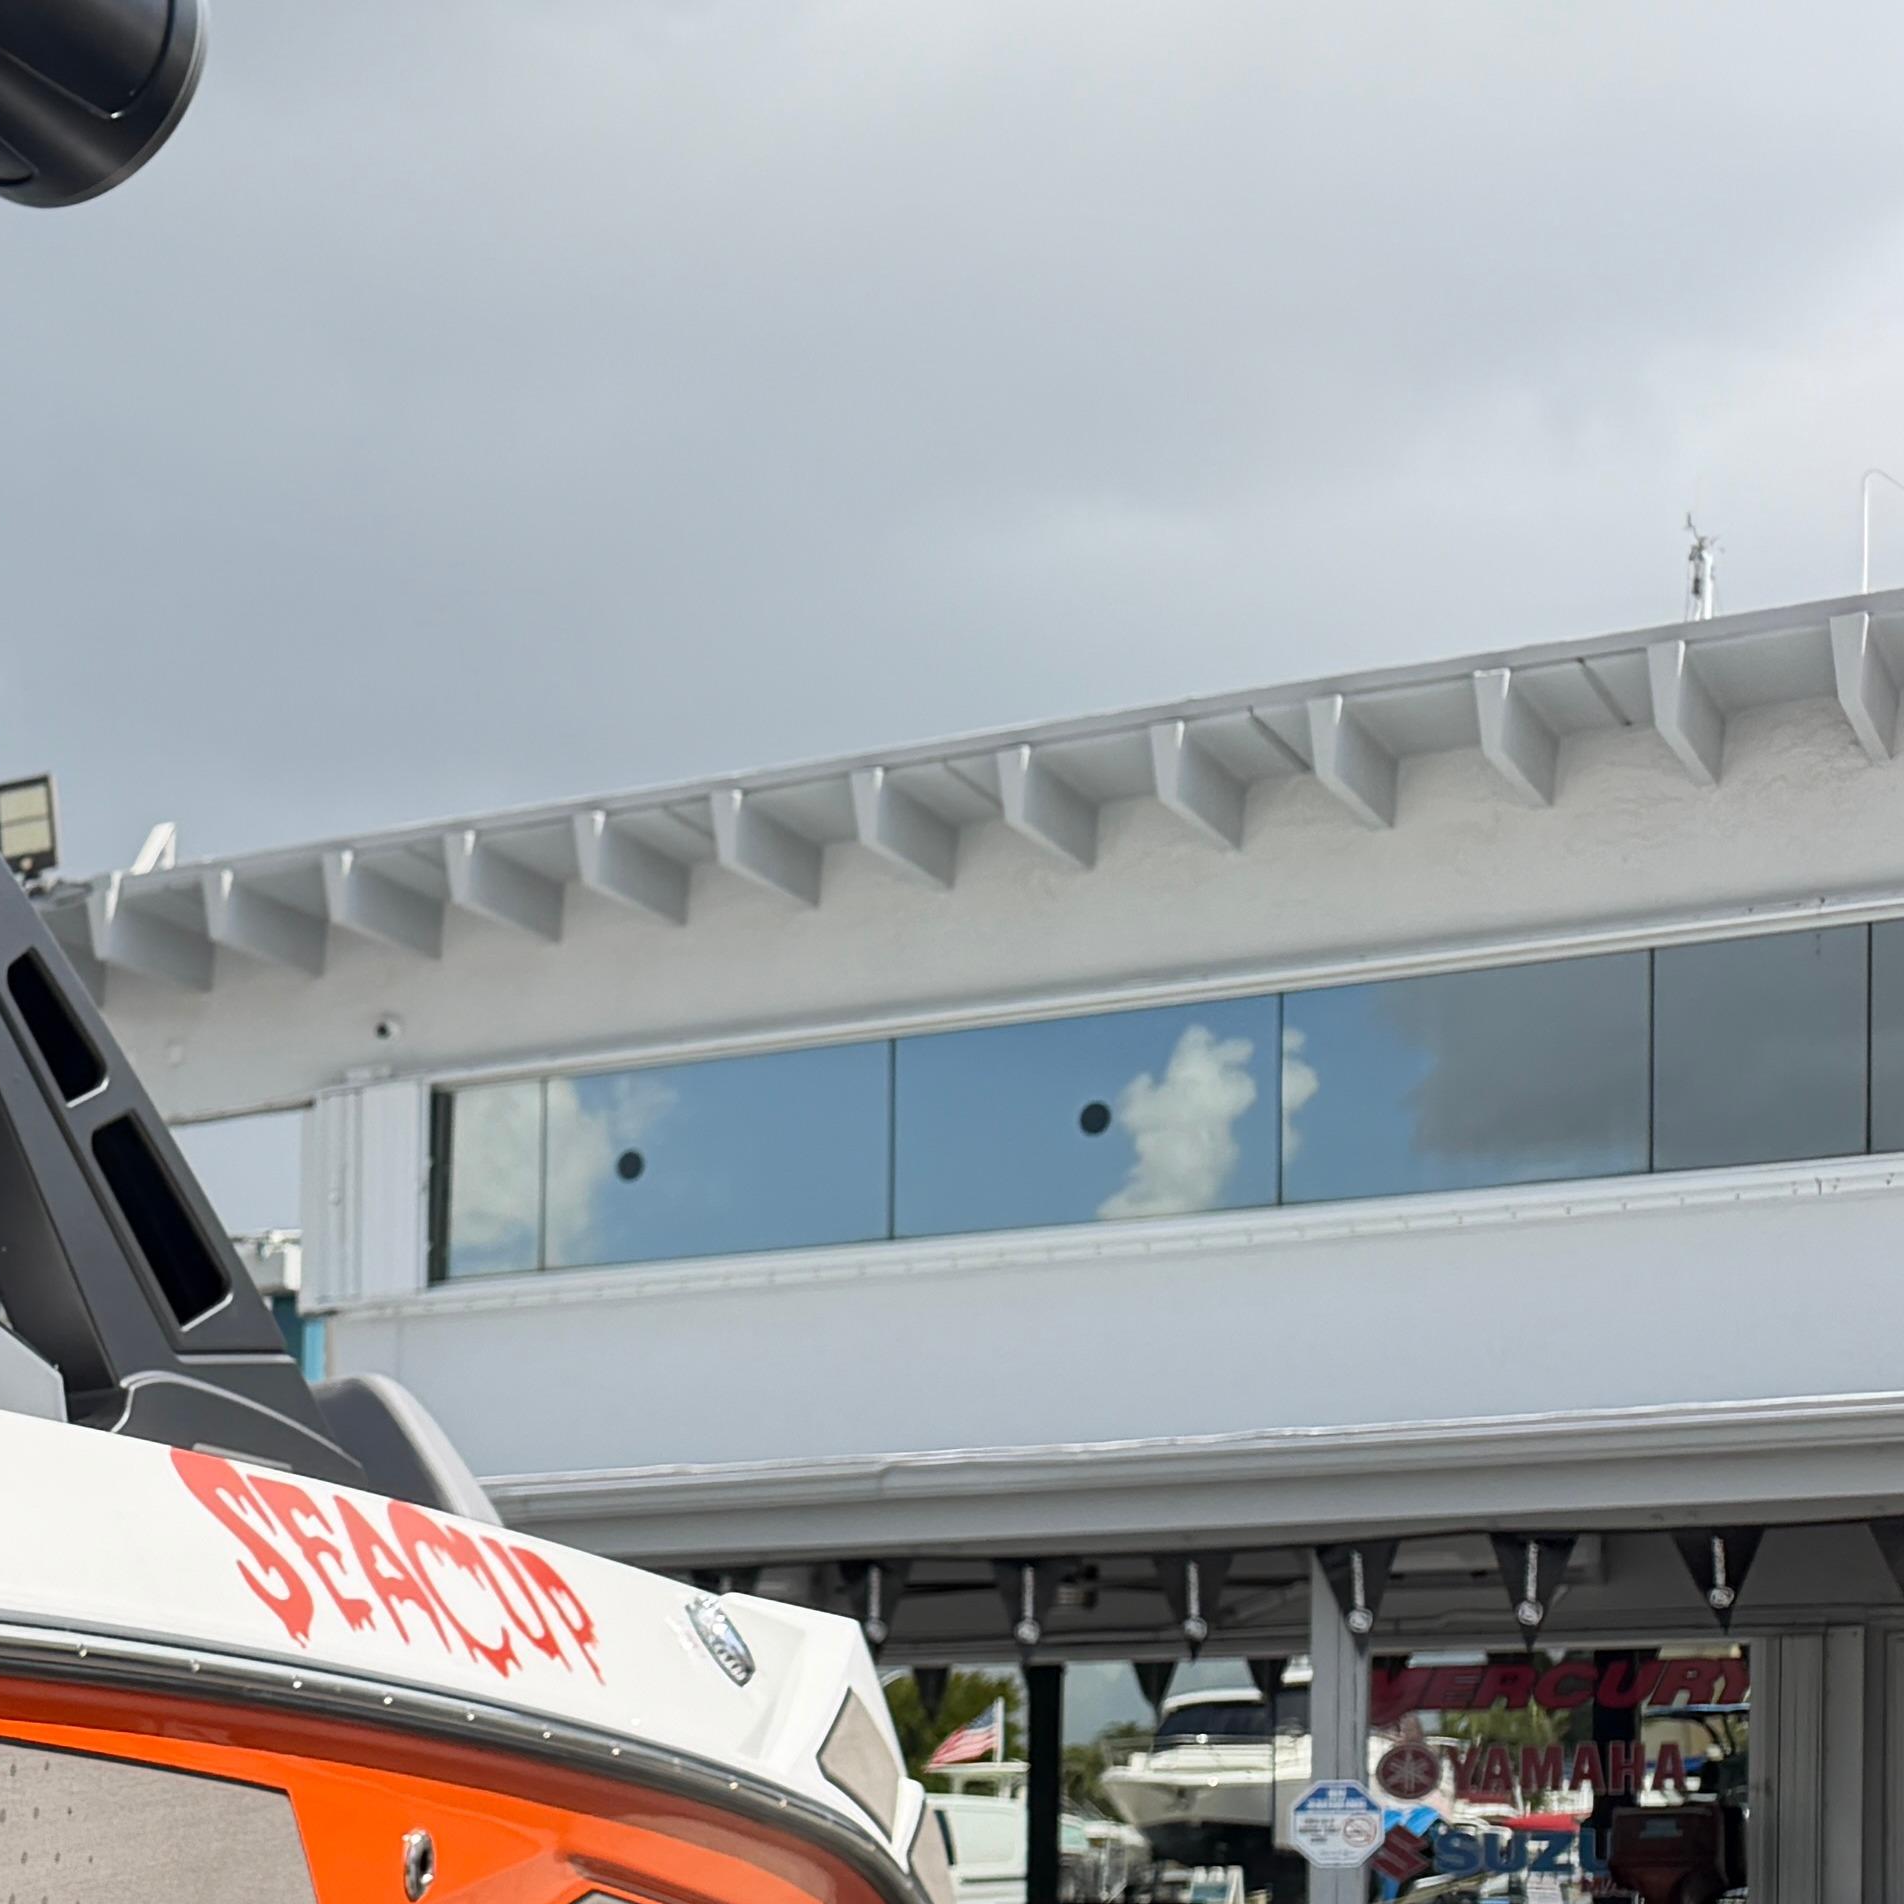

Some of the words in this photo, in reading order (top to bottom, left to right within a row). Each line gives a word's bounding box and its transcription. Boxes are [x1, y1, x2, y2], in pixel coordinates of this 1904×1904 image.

[170, 1446, 605, 1687] SEACUP
[1447, 1740, 1689, 1796] YAMAHA
[1433, 1828, 1611, 1877] SUZU
